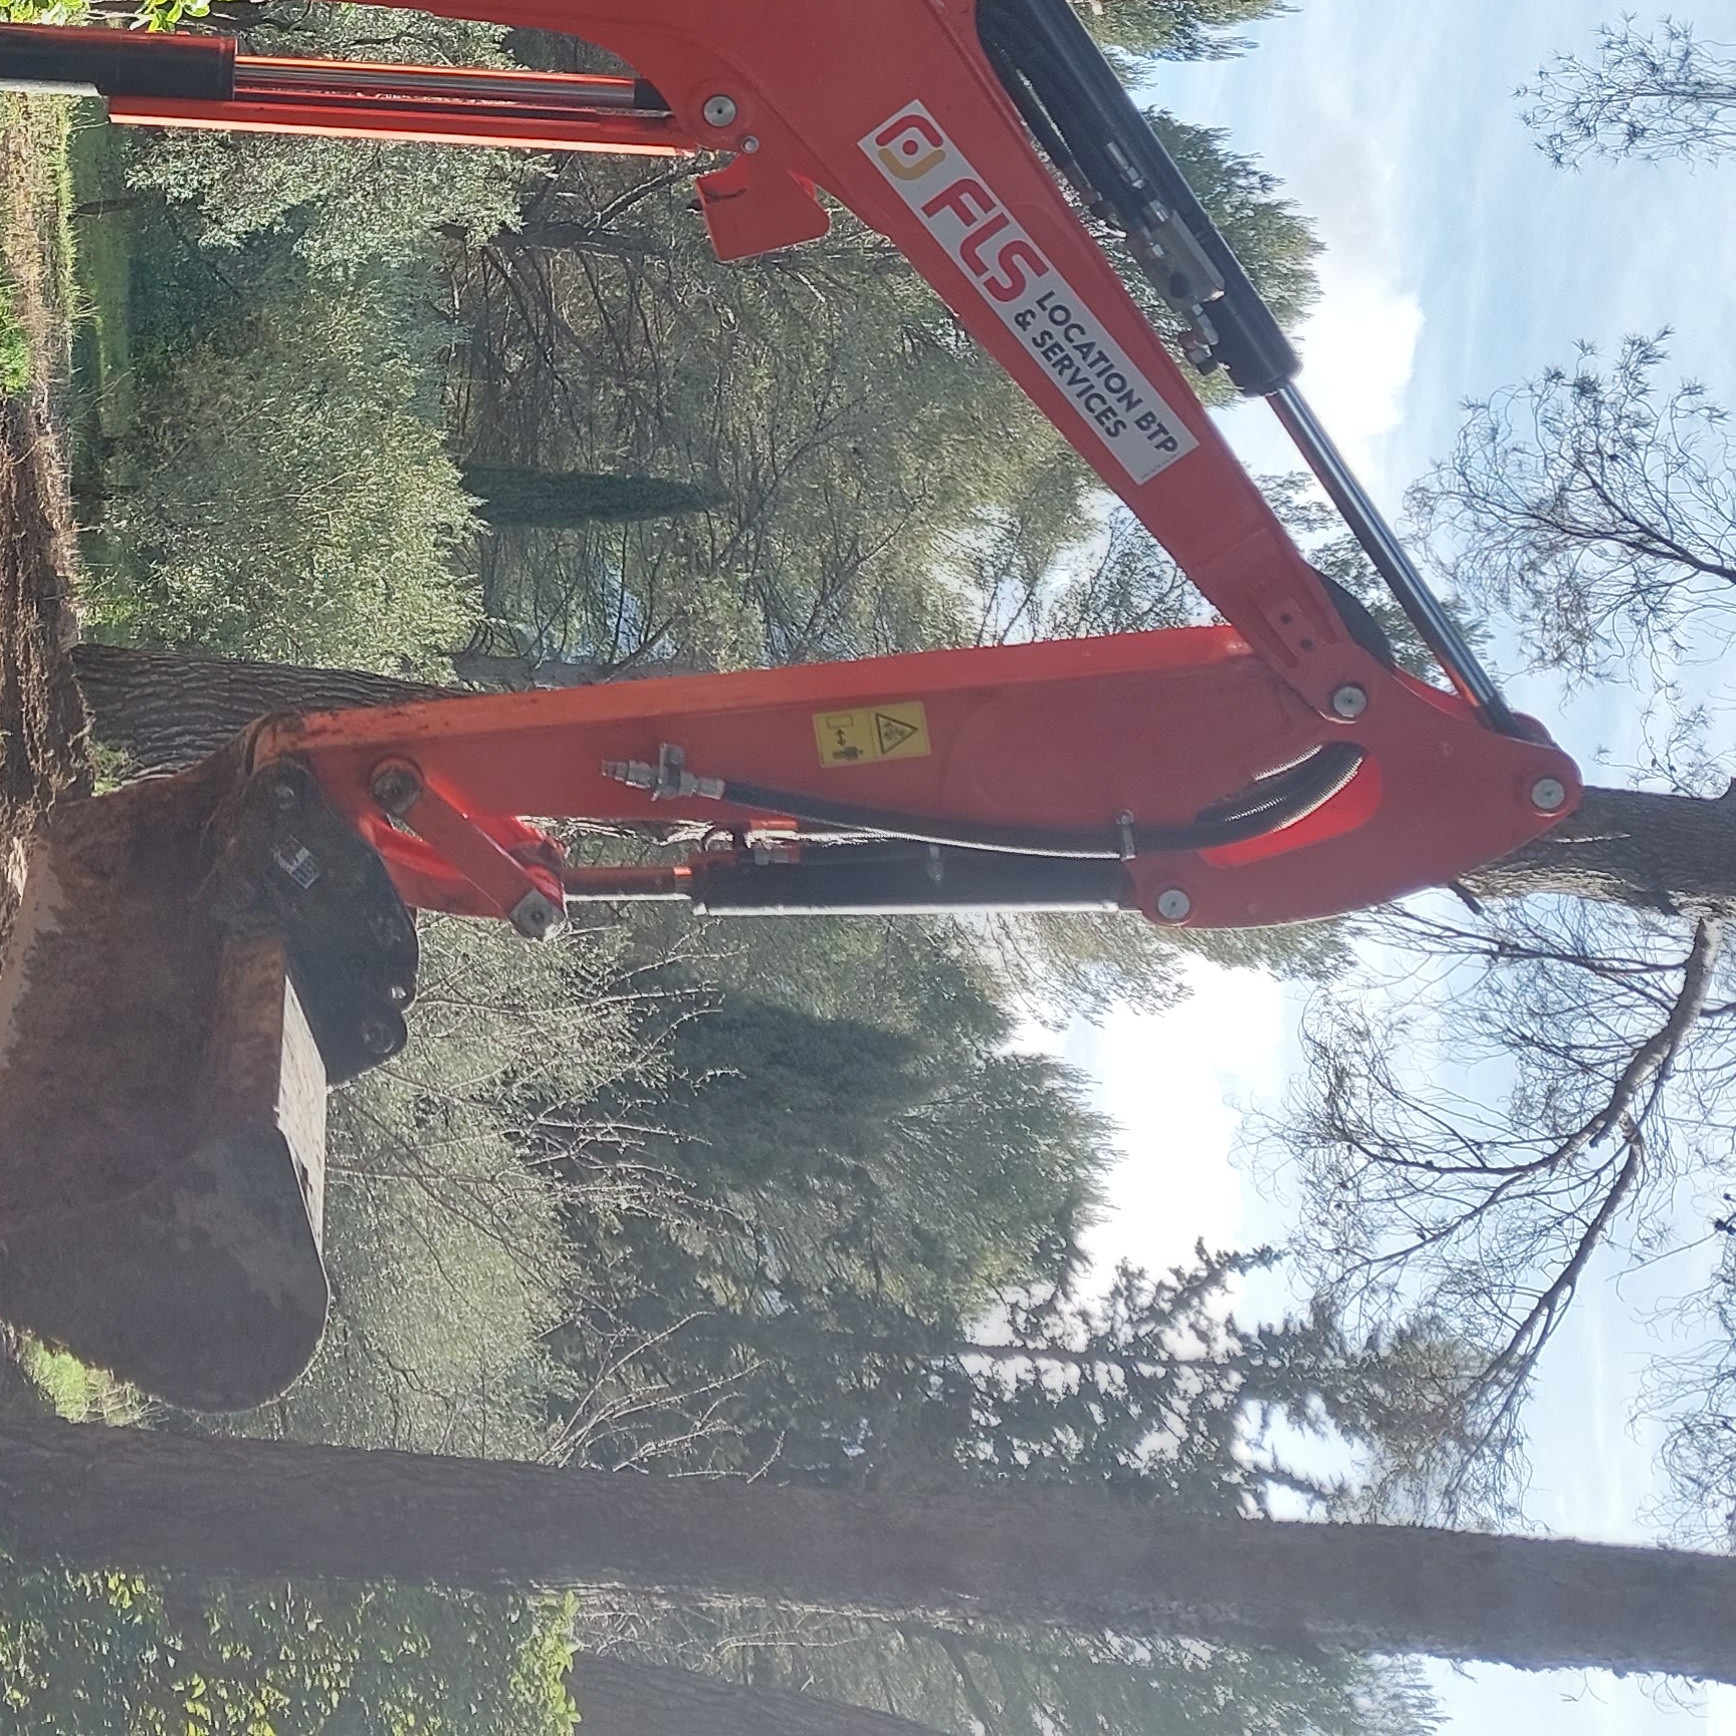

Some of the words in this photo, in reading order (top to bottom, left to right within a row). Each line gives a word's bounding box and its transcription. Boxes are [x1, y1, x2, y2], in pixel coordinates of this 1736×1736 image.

[921, 178, 1050, 303] FLS
[1013, 311, 1038, 333] &
[1031, 331, 1130, 439] SERVICES
[1035, 289, 1142, 412] LOCATION
[1133, 410, 1179, 452] BTP
